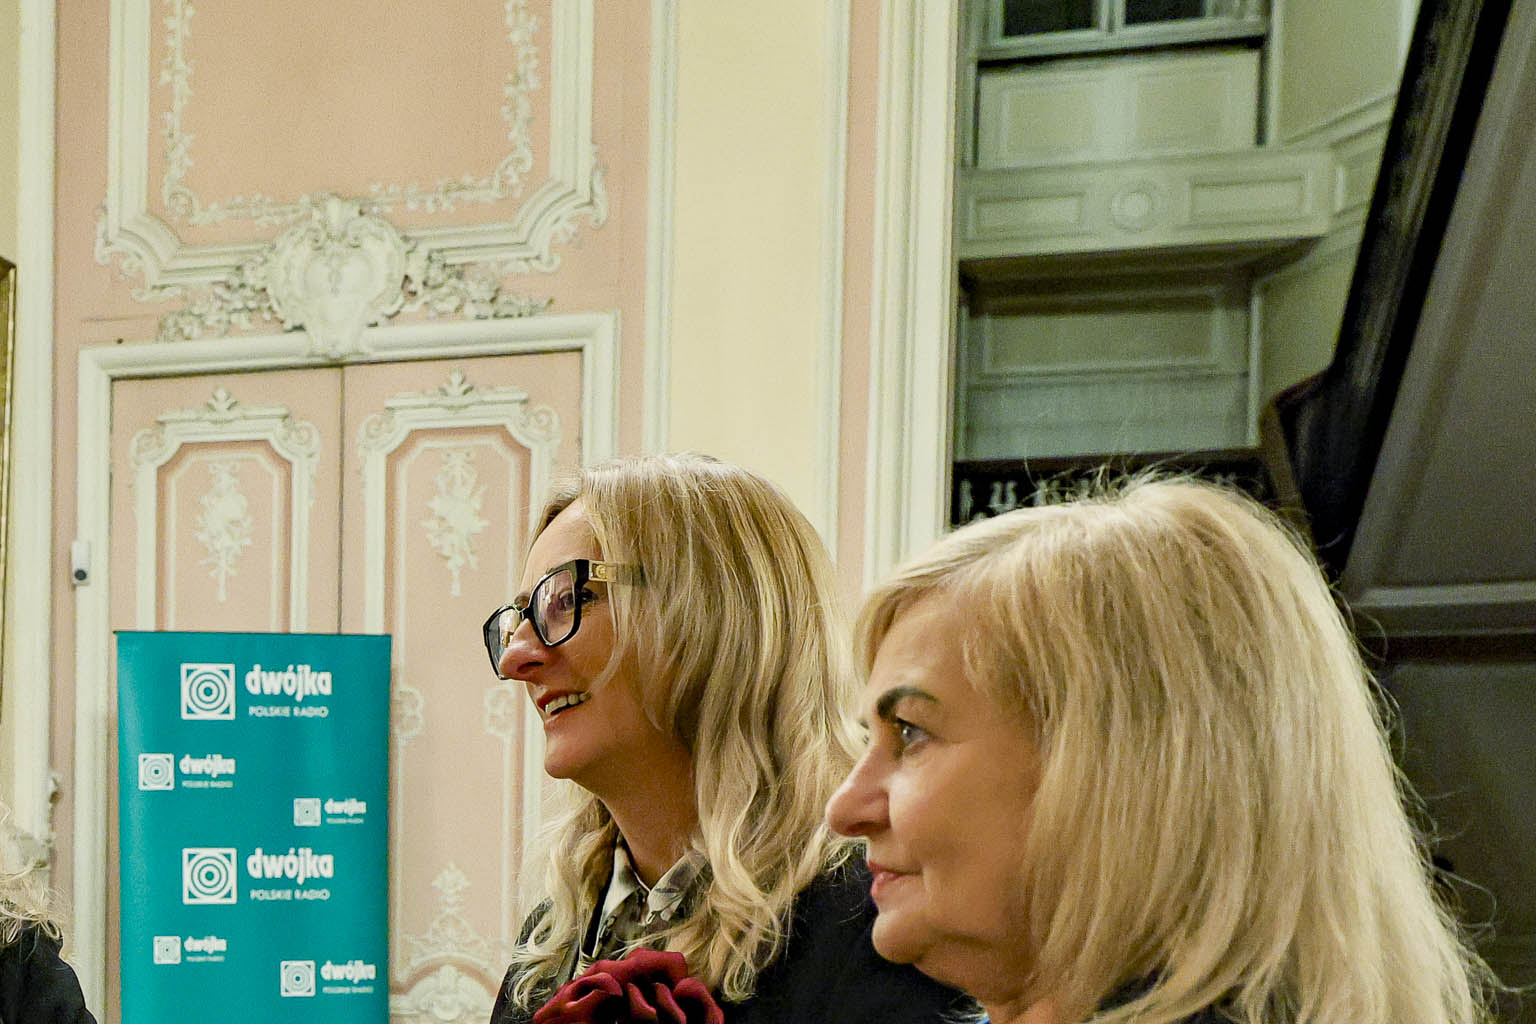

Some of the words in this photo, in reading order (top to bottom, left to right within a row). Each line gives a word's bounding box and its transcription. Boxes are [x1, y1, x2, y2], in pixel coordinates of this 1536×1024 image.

[245, 664, 332, 702] dwójka
[249, 706, 290, 717] POLSKIE
[293, 706, 328, 717] RADIO
[179, 754, 235, 778] dwójka
[247, 848, 334, 885] dwójka
[250, 889, 292, 900] POLSKIE
[295, 889, 330, 900] RADIO
[321, 960, 376, 984] dwójka
